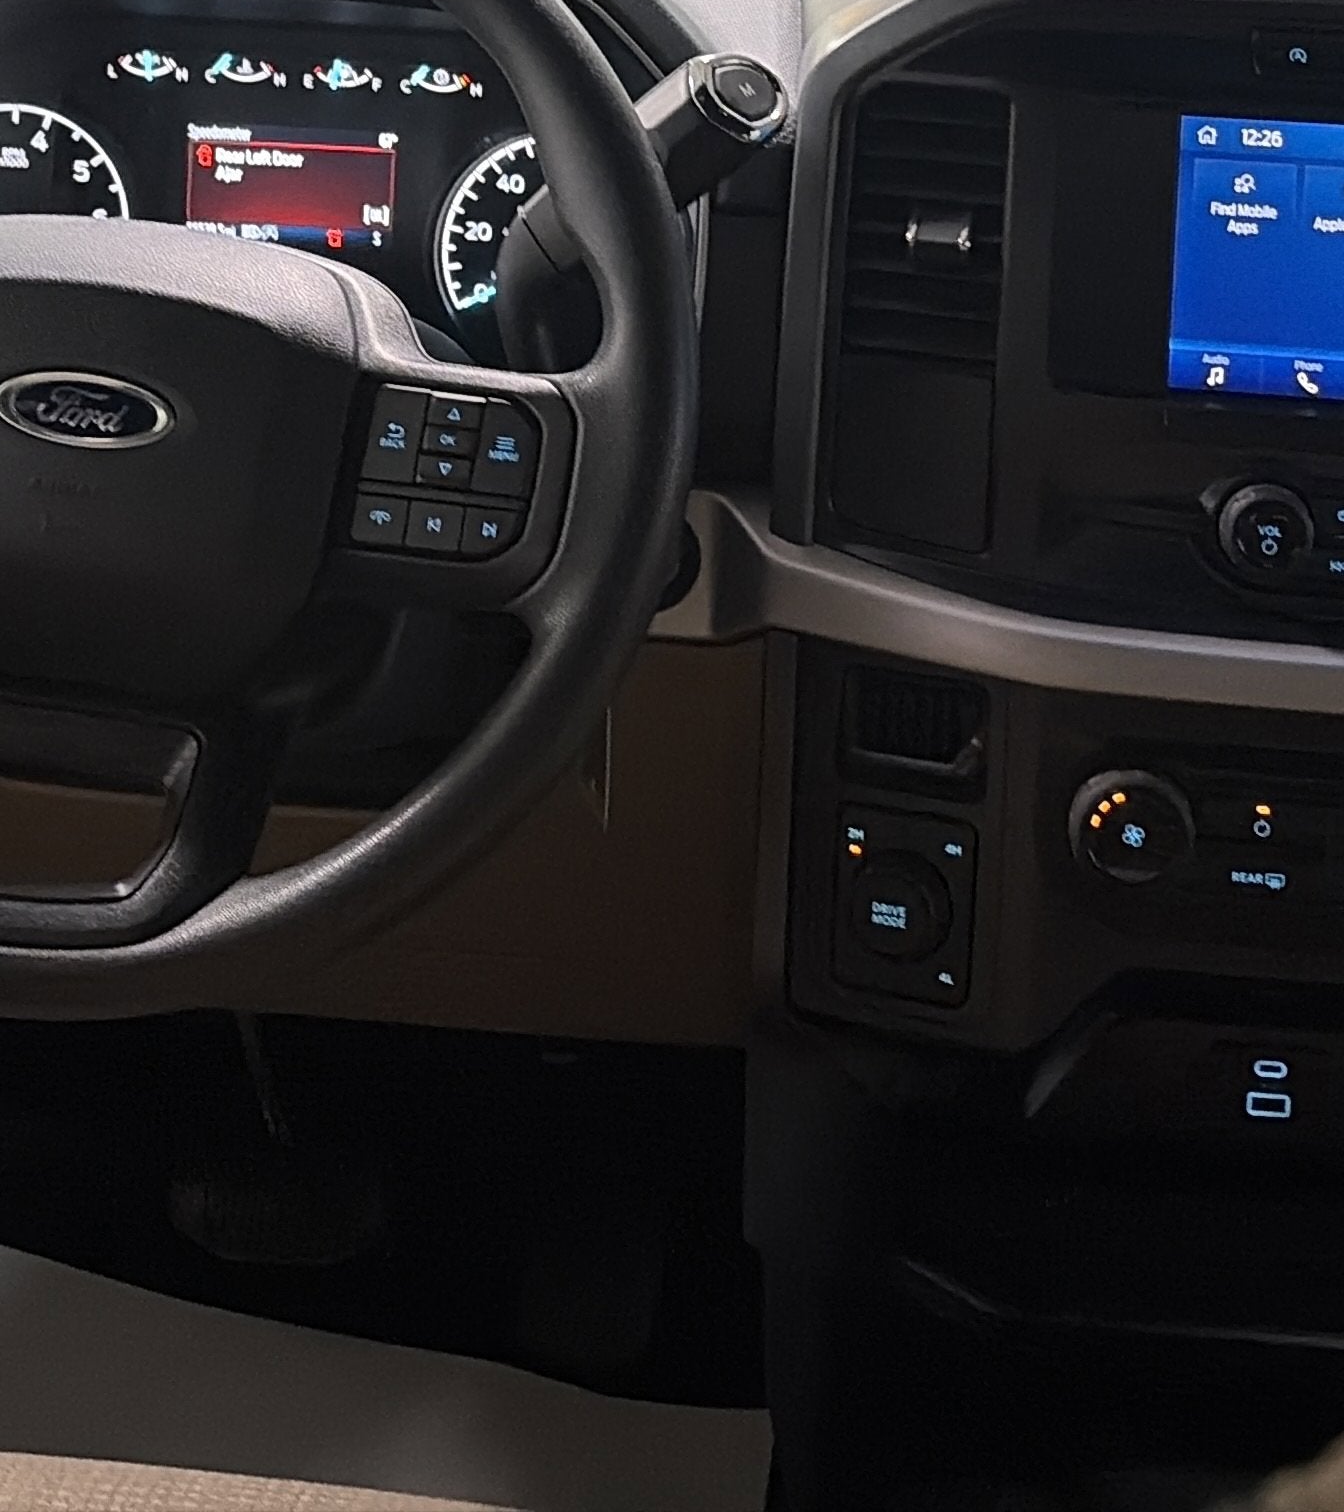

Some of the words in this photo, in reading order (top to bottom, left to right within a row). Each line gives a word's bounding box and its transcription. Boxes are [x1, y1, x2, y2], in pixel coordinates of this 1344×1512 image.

[303, 73, 315, 90] E
[371, 76, 383, 93] F
[399, 78, 412, 95] C
[29, 129, 49, 153] 4
[1241, 127, 1283, 148] 12:26
[215, 146, 245, 165] Rear
[245, 148, 272, 167] Left
[272, 149, 304, 168] Door
[72, 159, 91, 183] 5
[214, 165, 244, 184] Ajar
[495, 173, 525, 194] 40
[1209, 201, 1237, 217] Find
[1237, 203, 1278, 220] Mobile
[463, 220, 493, 242] 20
[1226, 219, 1259, 236] Apps
[1202, 353, 1230, 366] Audio
[1293, 359, 1324, 373] Phone
[36, 386, 129, 432] Ford
[1257, 524, 1282, 539] VOL
[1231, 871, 1263, 885] REAR
[871, 900, 906, 918] DRIVE
[871, 914, 907, 929] MODE
